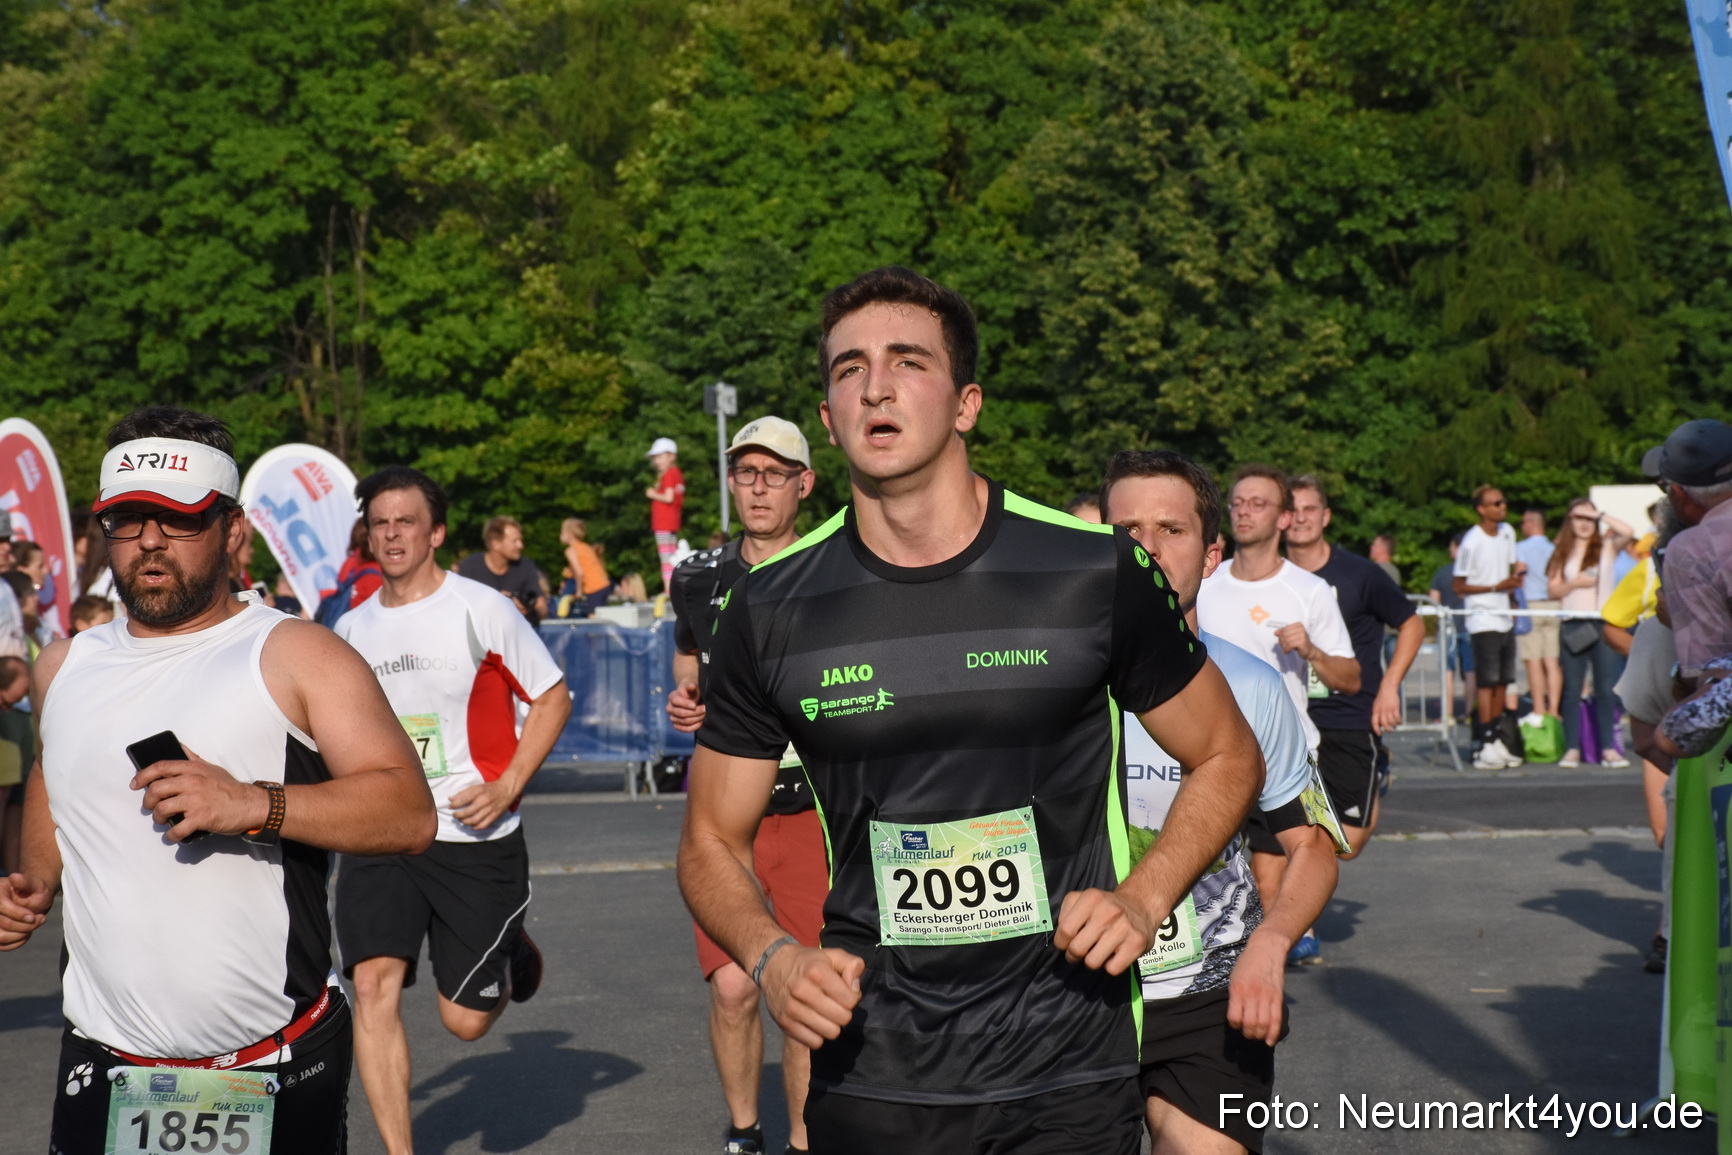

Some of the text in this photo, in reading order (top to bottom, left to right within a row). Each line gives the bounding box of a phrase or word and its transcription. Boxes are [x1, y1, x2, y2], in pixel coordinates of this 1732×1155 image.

[371, 654, 458, 677] ntellitools
[966, 649, 1049, 669] DOMINIK
[821, 664, 874, 687] JAKO
[821, 694, 875, 710] sarango
[824, 705, 873, 718] TEAMSPORT
[893, 846, 955, 860] firmenlauf
[997, 843, 1027, 857] 2019
[893, 859, 1020, 911] 2099
[894, 901, 1033, 925] Eckersberger Dominik
[899, 914, 1030, 935] Sarango Teamsport/ Dieter Böll
[1159, 942, 1186, 953] Kollo
[1142, 956, 1164, 965] GmbH
[300, 1061, 325, 1081] JAKO
[235, 1103, 264, 1113] 2019
[131, 1109, 250, 1155] 1855
